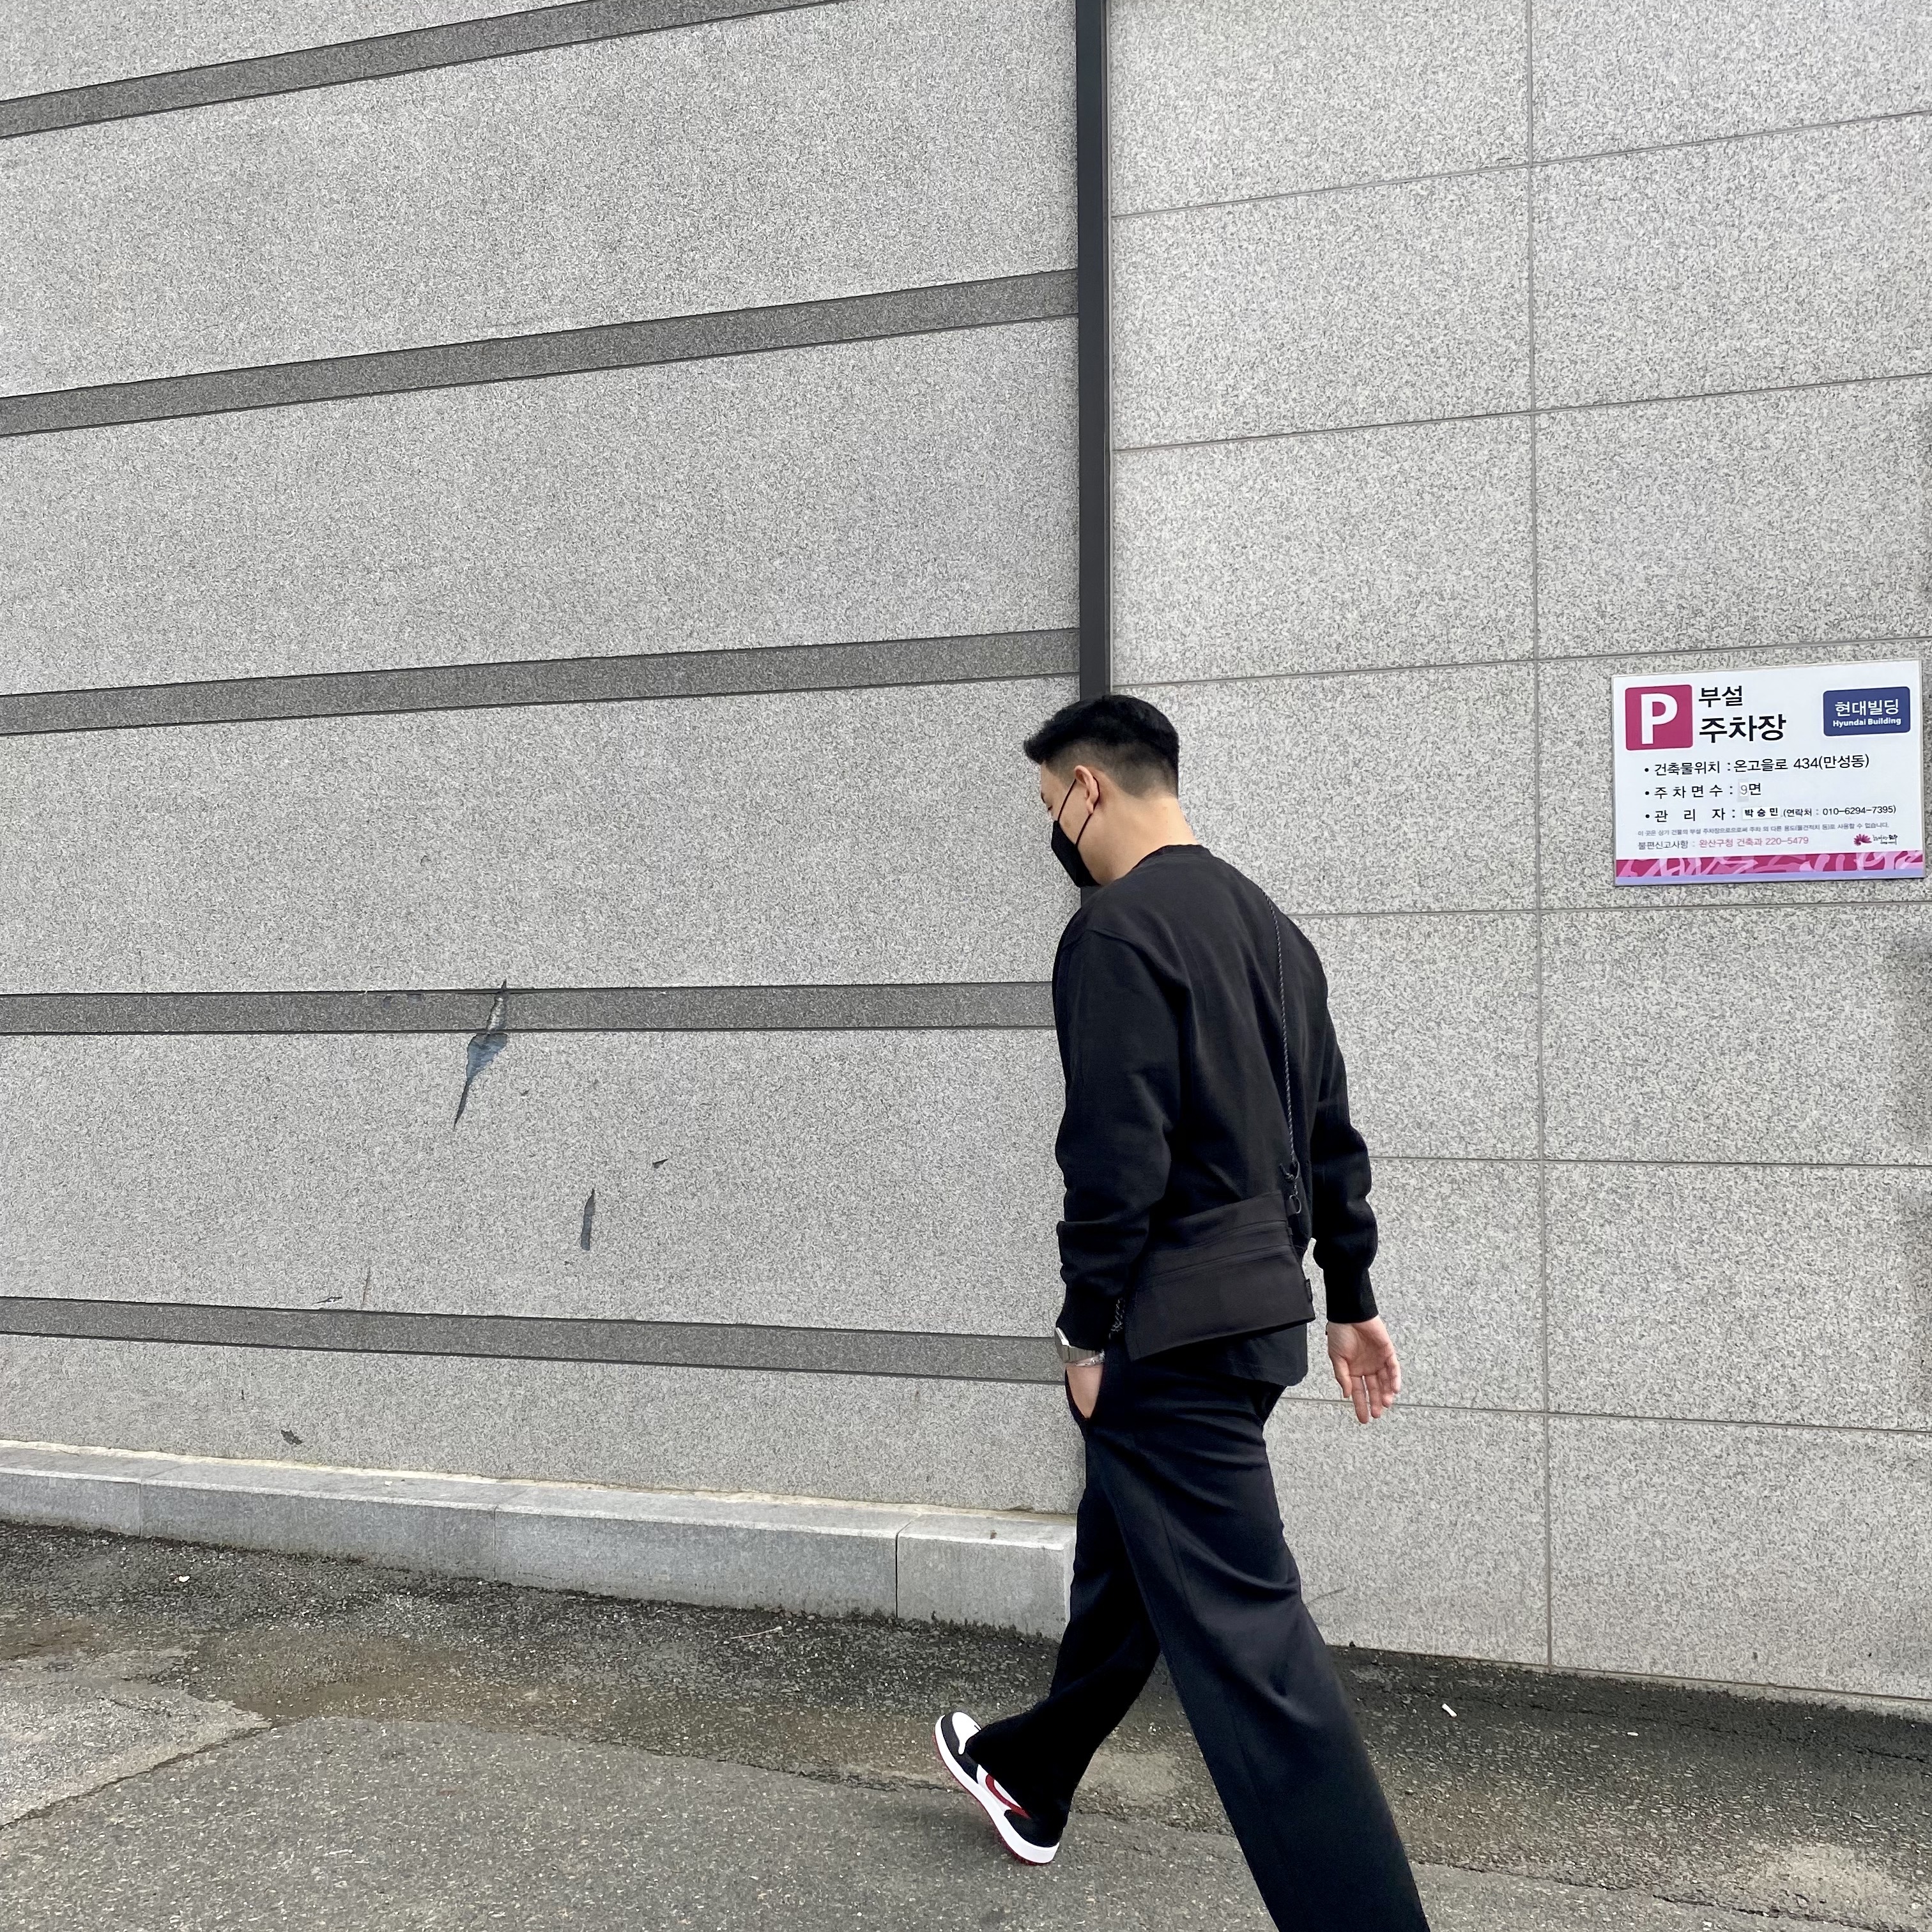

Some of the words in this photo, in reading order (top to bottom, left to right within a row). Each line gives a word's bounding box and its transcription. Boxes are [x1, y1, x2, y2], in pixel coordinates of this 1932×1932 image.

[1699, 686, 1742, 707] 부설
[1835, 699, 1899, 717] 현대빌딩
[1641, 693, 1678, 744] P
[1833, 719, 1866, 728] Hyundai
[1699, 714, 1786, 743] 주차장
[1655, 761, 1720, 776] 건축물위치
[1638, 841, 1688, 850] 불편신고사항
[1699, 839, 1733, 848] 완산구청
[1737, 838, 1762, 847] 건축과
[1766, 836, 1809, 845] 220-5479
